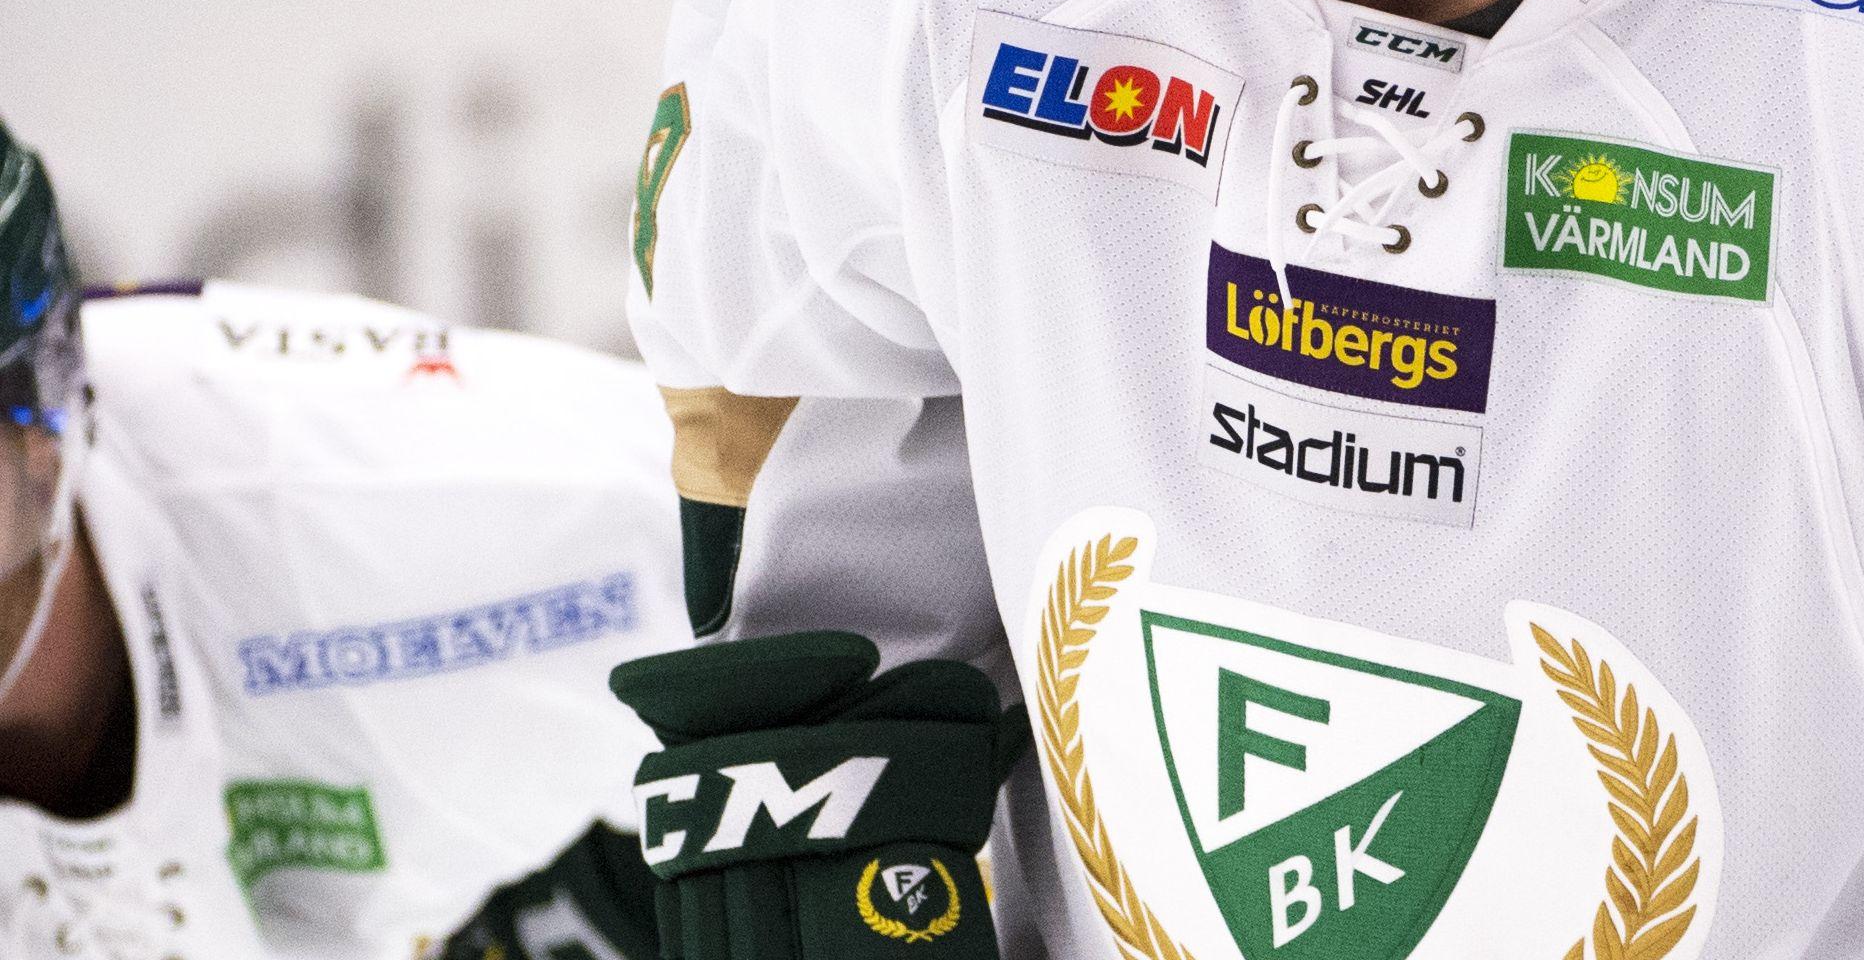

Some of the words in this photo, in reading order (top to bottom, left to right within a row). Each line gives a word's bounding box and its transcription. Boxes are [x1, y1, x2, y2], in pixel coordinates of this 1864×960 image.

[1355, 25, 1459, 63] CCM
[1355, 78, 1430, 119] SHL
[981, 42, 1220, 168] ELON
[1524, 204, 1751, 282] VÄRMLAND
[1226, 281, 1459, 390] Löfbergs
[1218, 666, 1332, 823] F
[1268, 790, 1406, 950] BK
